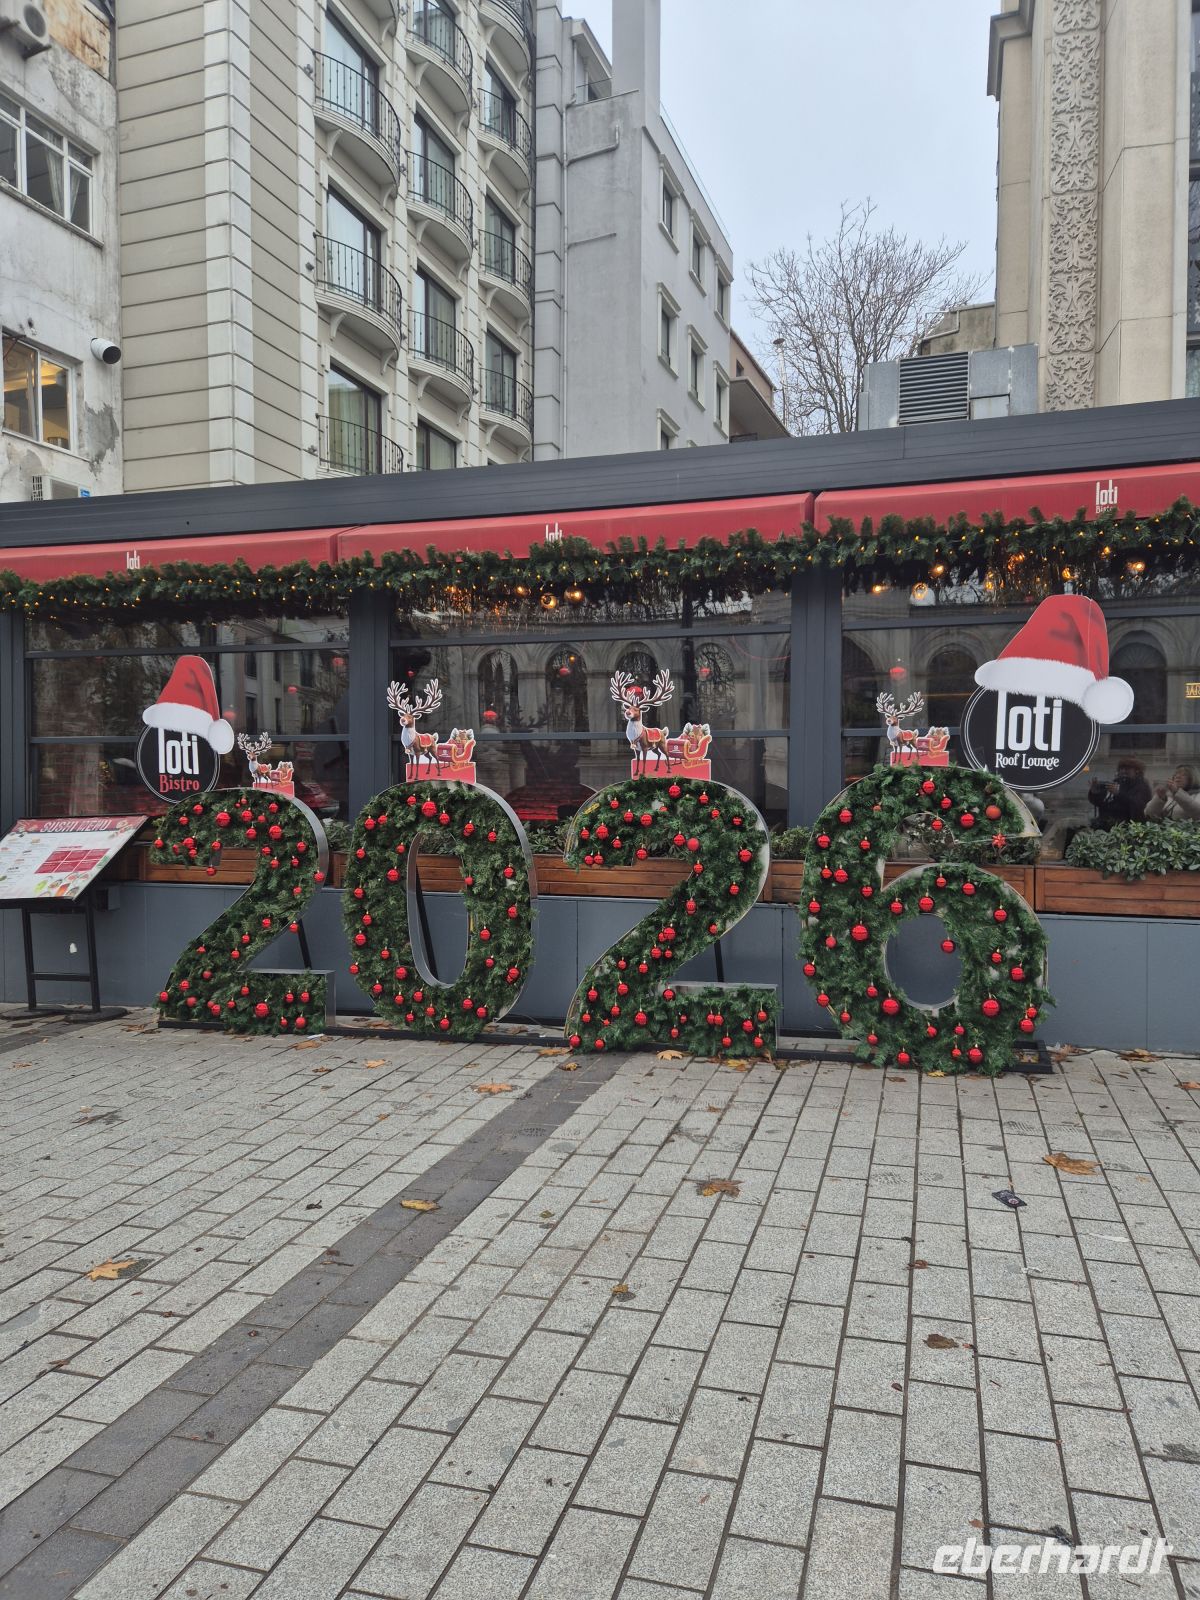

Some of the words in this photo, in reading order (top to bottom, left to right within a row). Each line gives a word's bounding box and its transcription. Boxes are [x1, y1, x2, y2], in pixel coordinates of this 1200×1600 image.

[1096, 479, 1118, 505] loti
[995, 690, 1063, 752] loti
[157, 727, 200, 775] loti
[995, 752, 1019, 768] Roof
[1022, 752, 1060, 771] Lounge
[159, 774, 200, 793] Bistro
[40, 820, 79, 833] SUSHI
[76, 819, 113, 832] MENU
[152, 762, 1054, 1077] 2026
